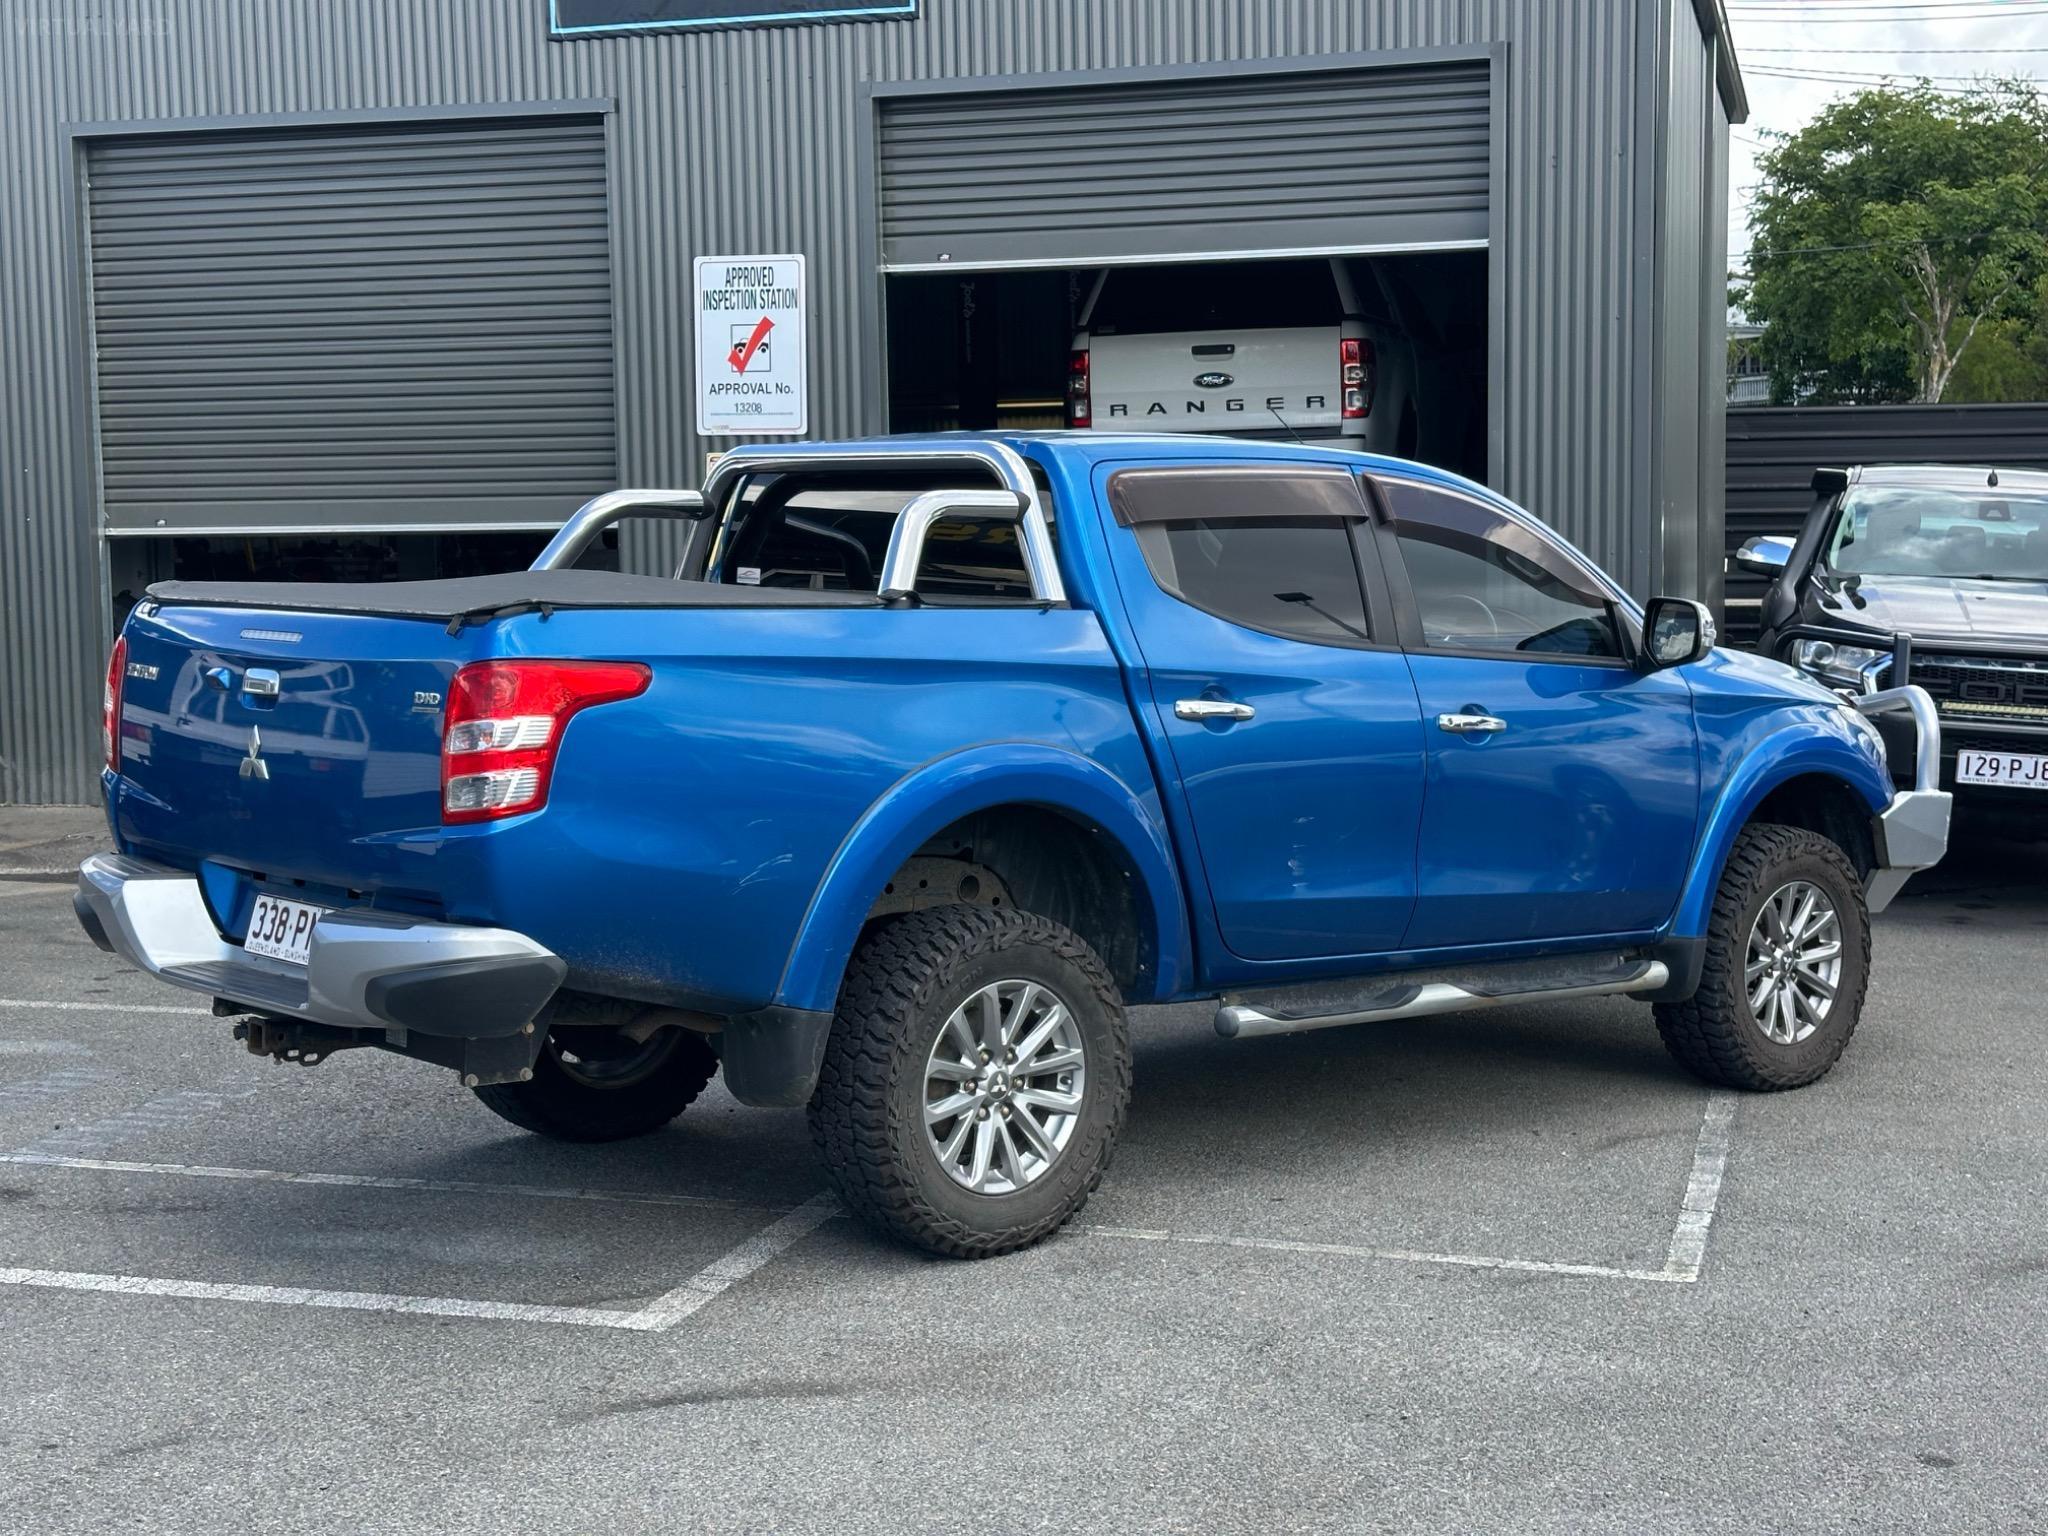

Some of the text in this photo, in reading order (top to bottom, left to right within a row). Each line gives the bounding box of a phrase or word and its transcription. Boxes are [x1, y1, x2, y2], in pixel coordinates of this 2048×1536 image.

[724, 266, 775, 288] APPROVED
[703, 288, 798, 311] INSPECTION STATION
[709, 382, 794, 395] APPROVAL No.
[734, 402, 763, 414] 13208
[1109, 395, 1326, 417] RANGER
